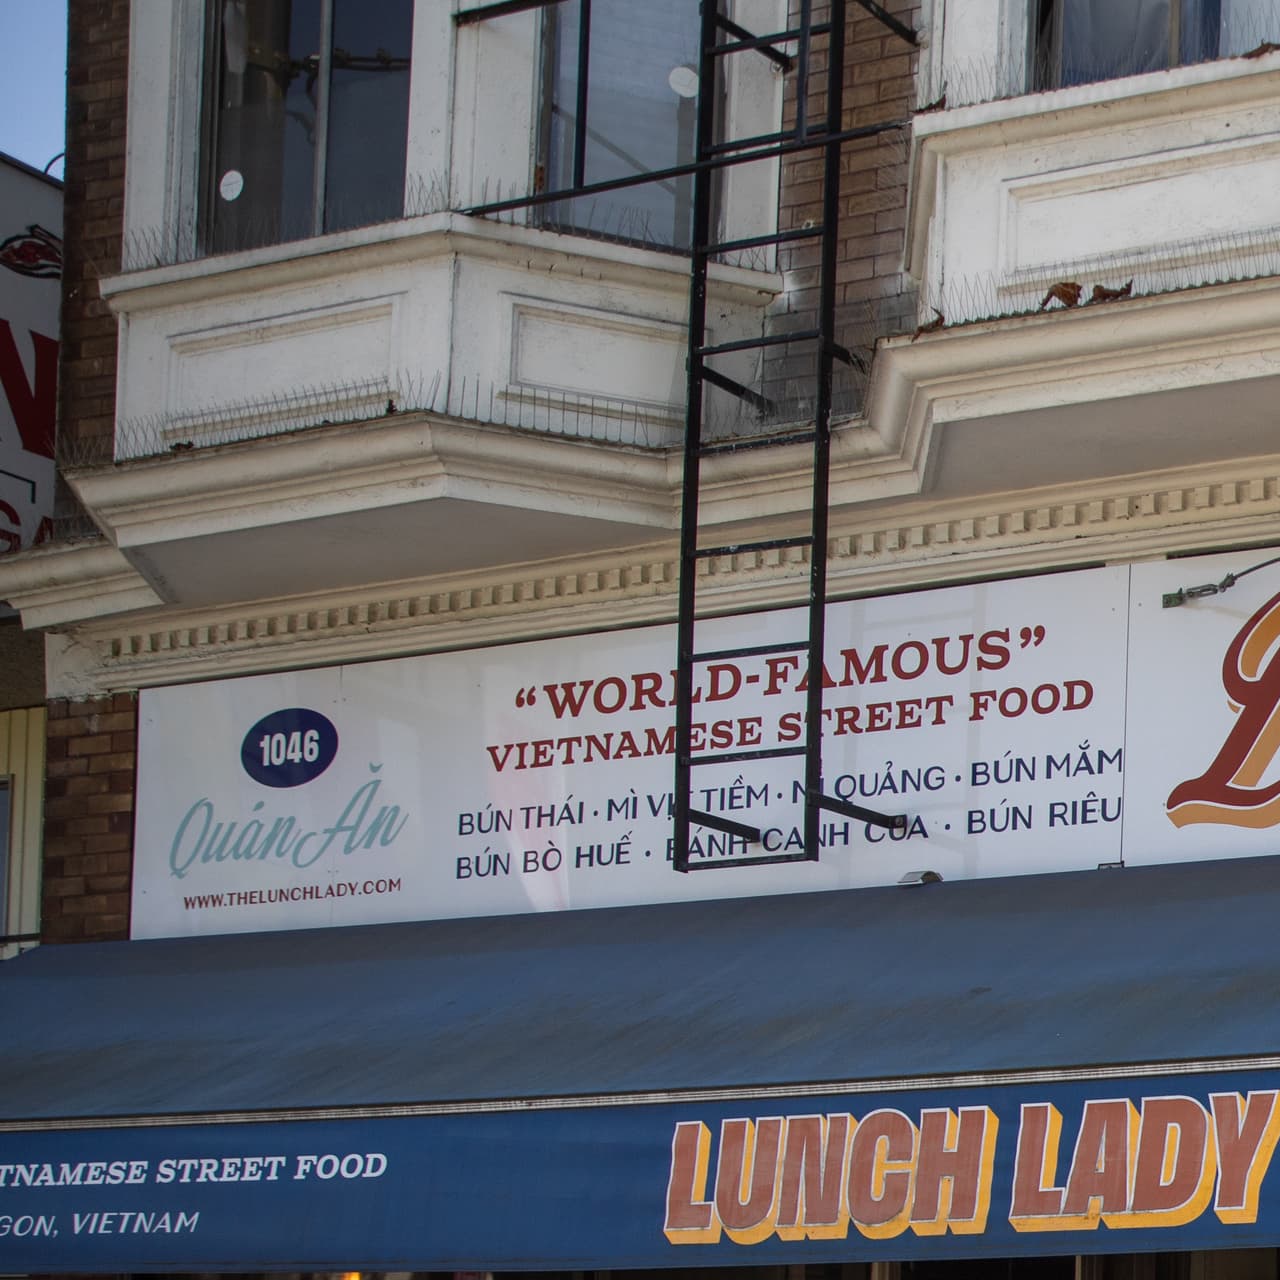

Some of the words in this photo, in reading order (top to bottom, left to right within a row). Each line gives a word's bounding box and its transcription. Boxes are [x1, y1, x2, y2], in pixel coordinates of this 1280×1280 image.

[259, 728, 320, 768] 1046
[486, 717, 763, 773] VIETNAMESE
[968, 678, 1095, 723] FOOD
[169, 797, 302, 880] Quán
[293, 761, 410, 868] Ăn
[457, 799, 513, 836] BÚN
[519, 793, 585, 830] THÁI
[607, 787, 639, 821] MÌ
[700, 774, 770, 813] TIỀM
[833, 760, 946, 805] QUẢNG
[970, 750, 1036, 788] BÚN
[1044, 740, 1125, 778] MẮM
[456, 841, 511, 880] BÚN
[522, 837, 563, 874] BÒ
[575, 829, 633, 869] HUẾ
[966, 803, 1033, 837] BÚN
[1049, 791, 1123, 829] RIÊU
[183, 878, 402, 911] WWW.THELUNCHLADY.COM
[156, 1156, 287, 1186] STREET
[293, 1152, 388, 1182] FOOD
[663, 1104, 1000, 1246] LUNCH
[72, 1210, 200, 1237] VIETNAM
